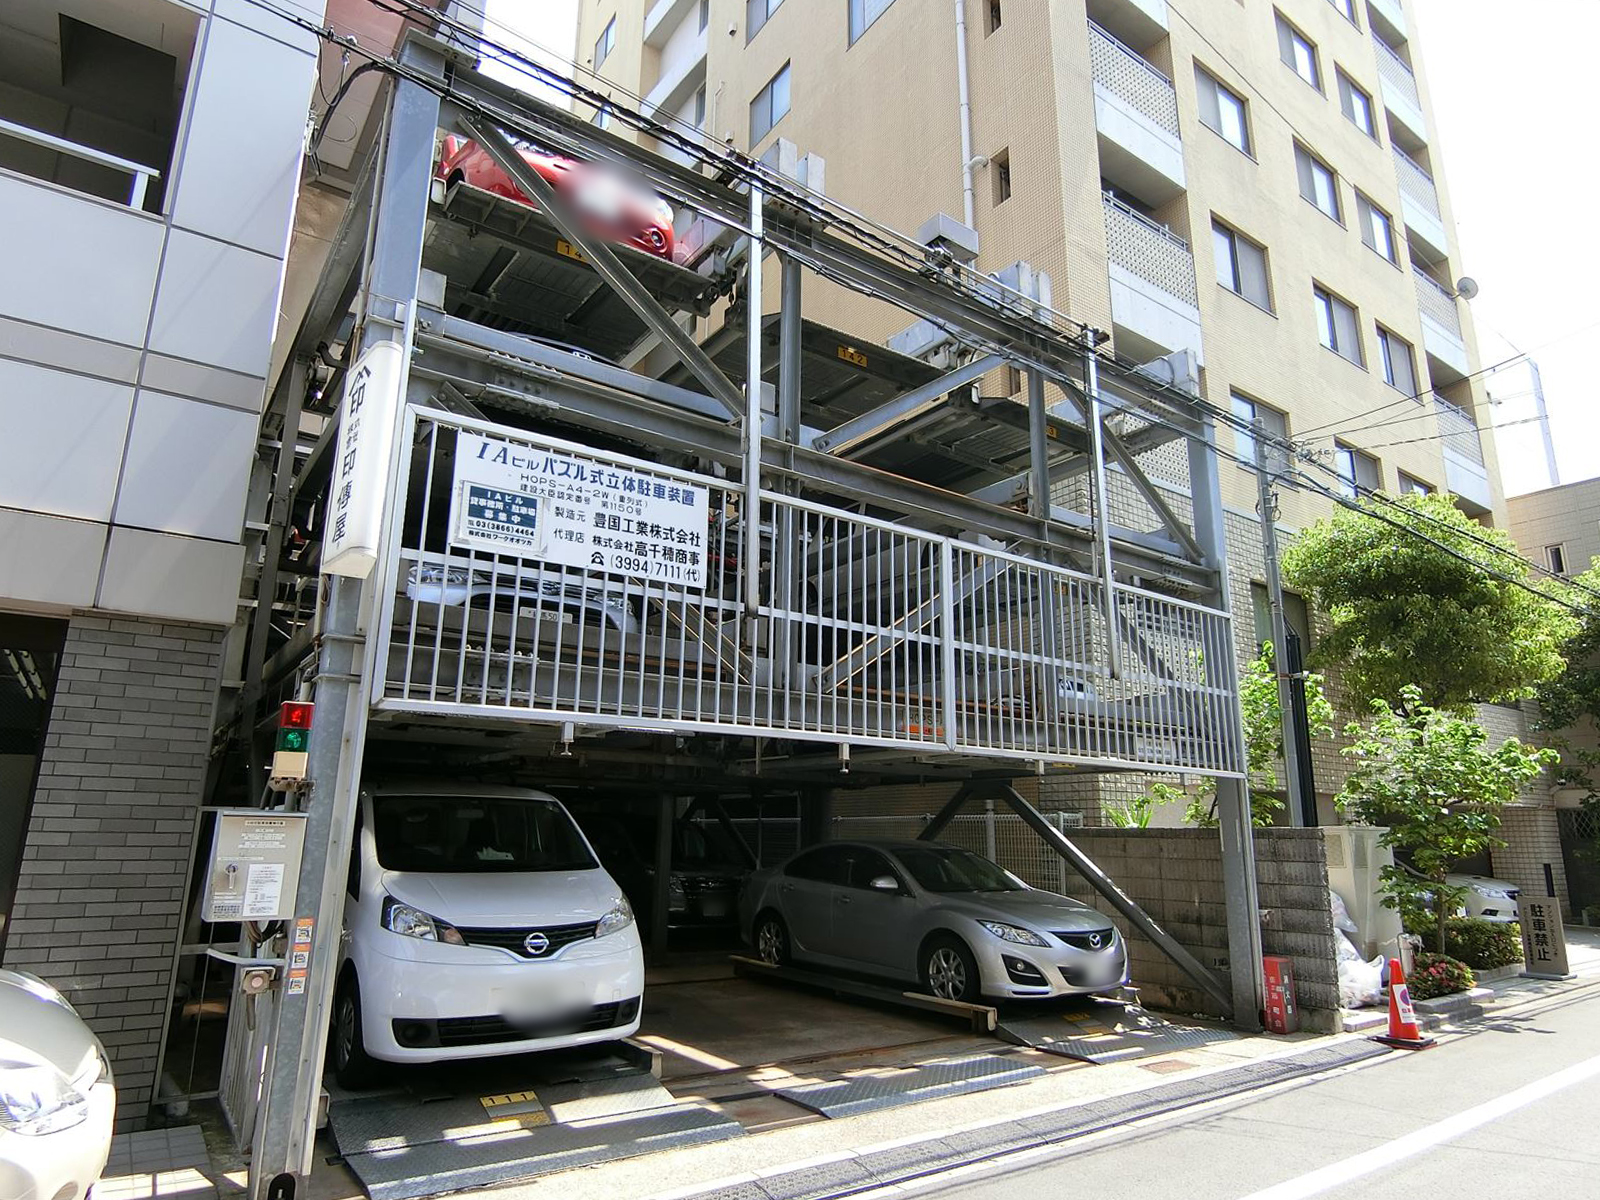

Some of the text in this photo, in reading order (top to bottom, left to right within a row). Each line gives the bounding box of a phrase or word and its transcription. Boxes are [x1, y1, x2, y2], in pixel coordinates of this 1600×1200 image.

[520, 483, 591, 505] 建設大臣認定番号
[554, 506, 701, 548] 製造元 豊国工業株式会社
[553, 529, 701, 566] 代理店 株式会社高千穂商事
[1530, 904, 1551, 961] 駐車禁止
[489, 1094, 527, 1105] 111
